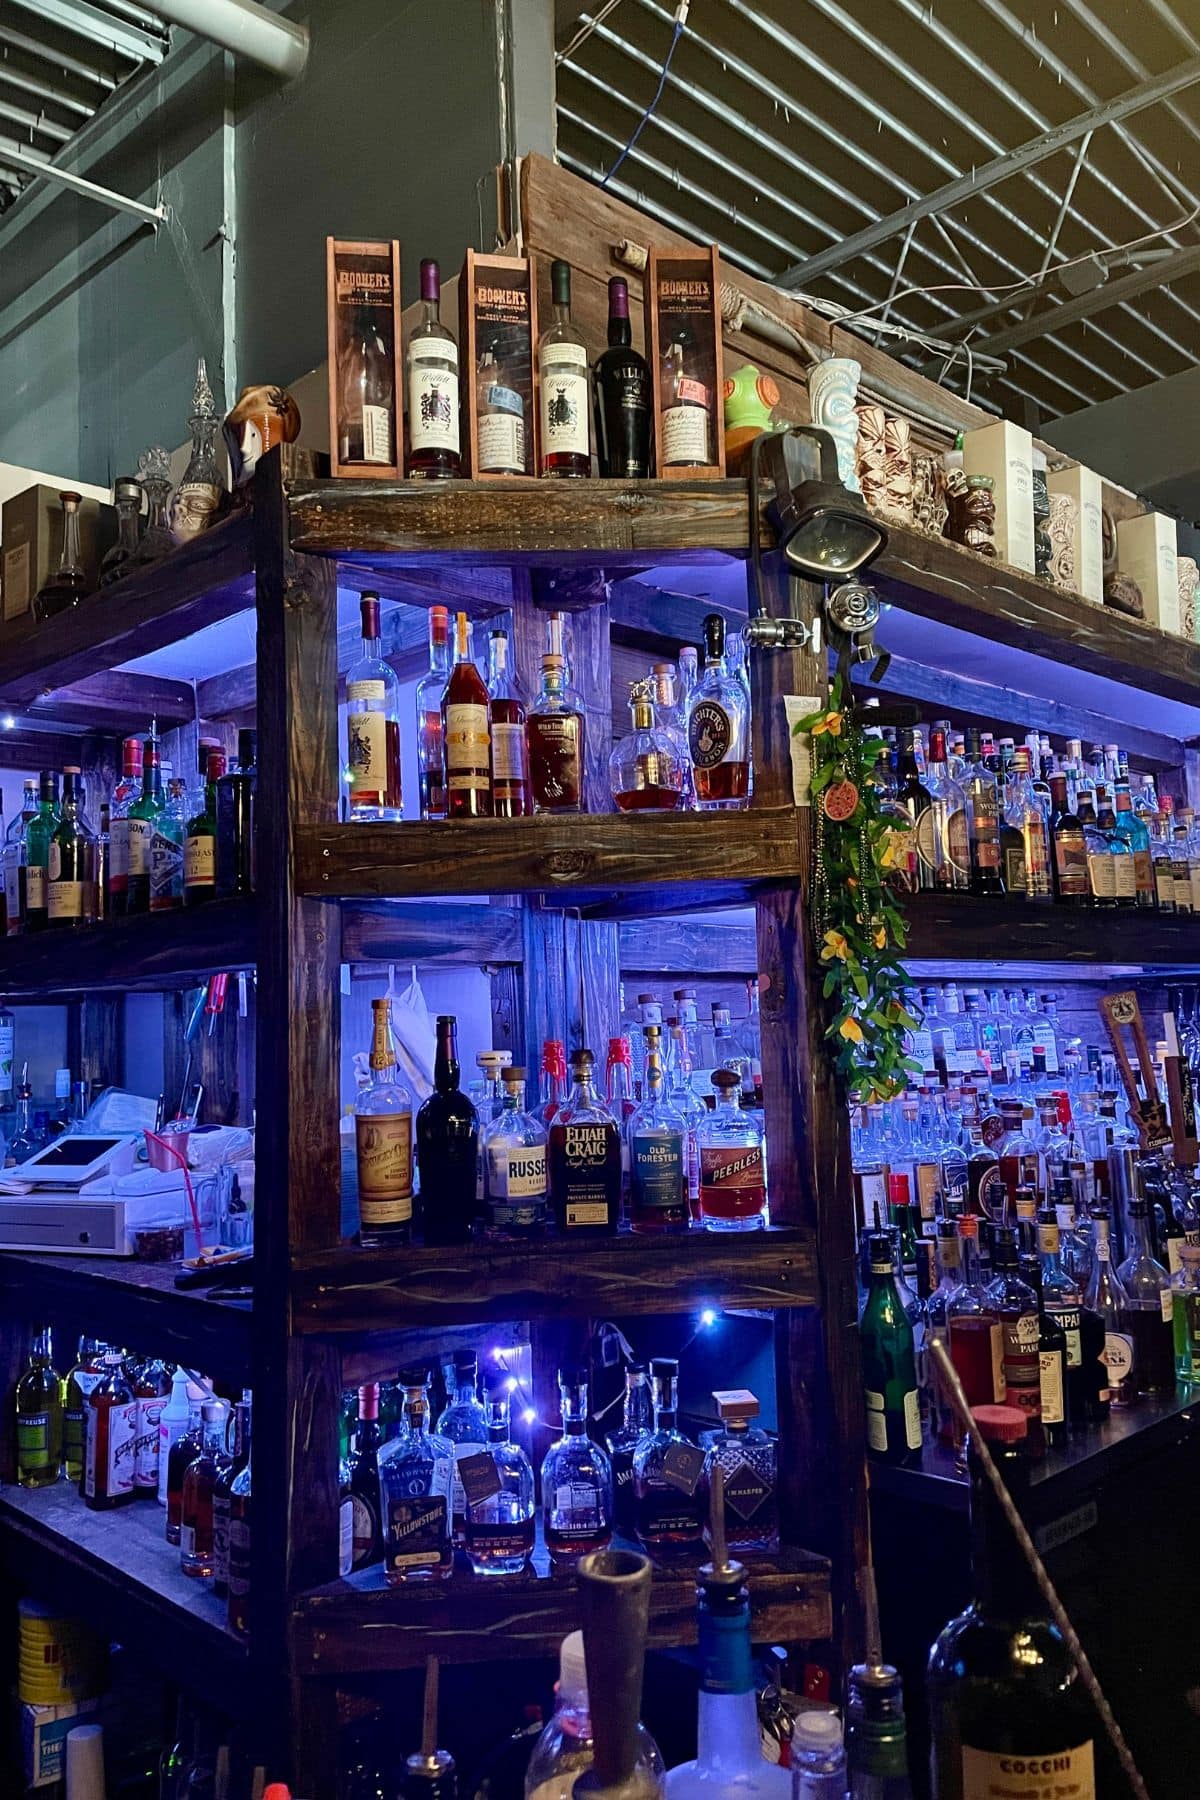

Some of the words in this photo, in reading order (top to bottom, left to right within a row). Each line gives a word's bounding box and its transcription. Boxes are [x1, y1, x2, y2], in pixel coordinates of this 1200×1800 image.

[566, 1127, 606, 1143] ELIJAH
[565, 1141, 606, 1158] CRAIG
[638, 1153, 678, 1163] FORESTER
[650, 1146, 666, 1154] OLD
[713, 1148, 760, 1182] PEERLESS
[391, 1506, 444, 1541] YELLOWSTONE
[1000, 1756, 1071, 1775] COCCHI
